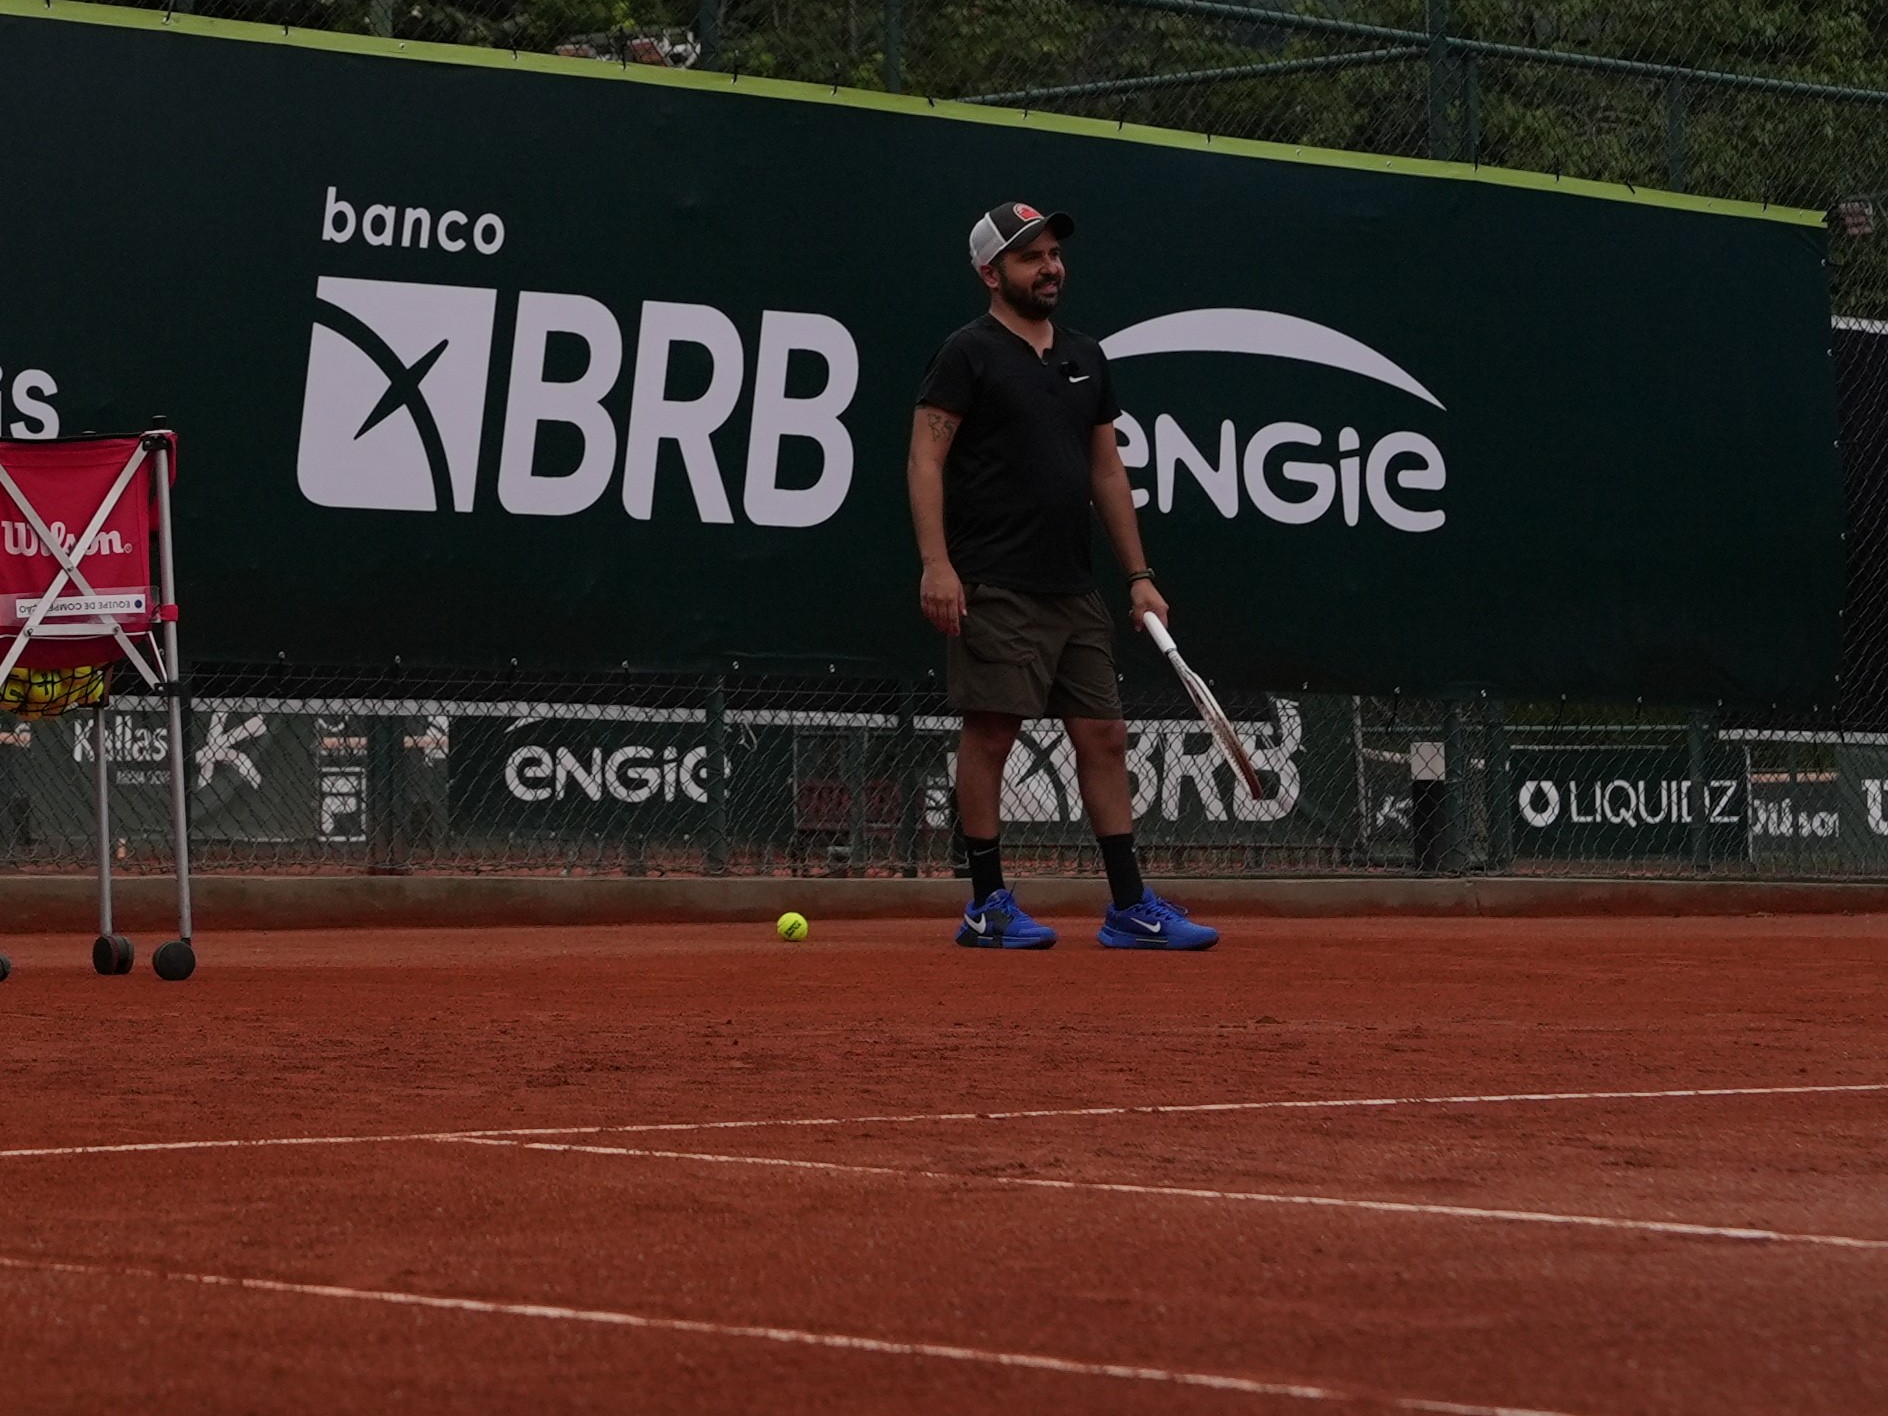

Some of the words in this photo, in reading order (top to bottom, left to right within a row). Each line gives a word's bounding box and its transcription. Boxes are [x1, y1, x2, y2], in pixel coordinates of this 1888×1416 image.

[321, 185, 505, 255] banco
[497, 290, 859, 528] BRB
[84, 601, 96, 611] DE
